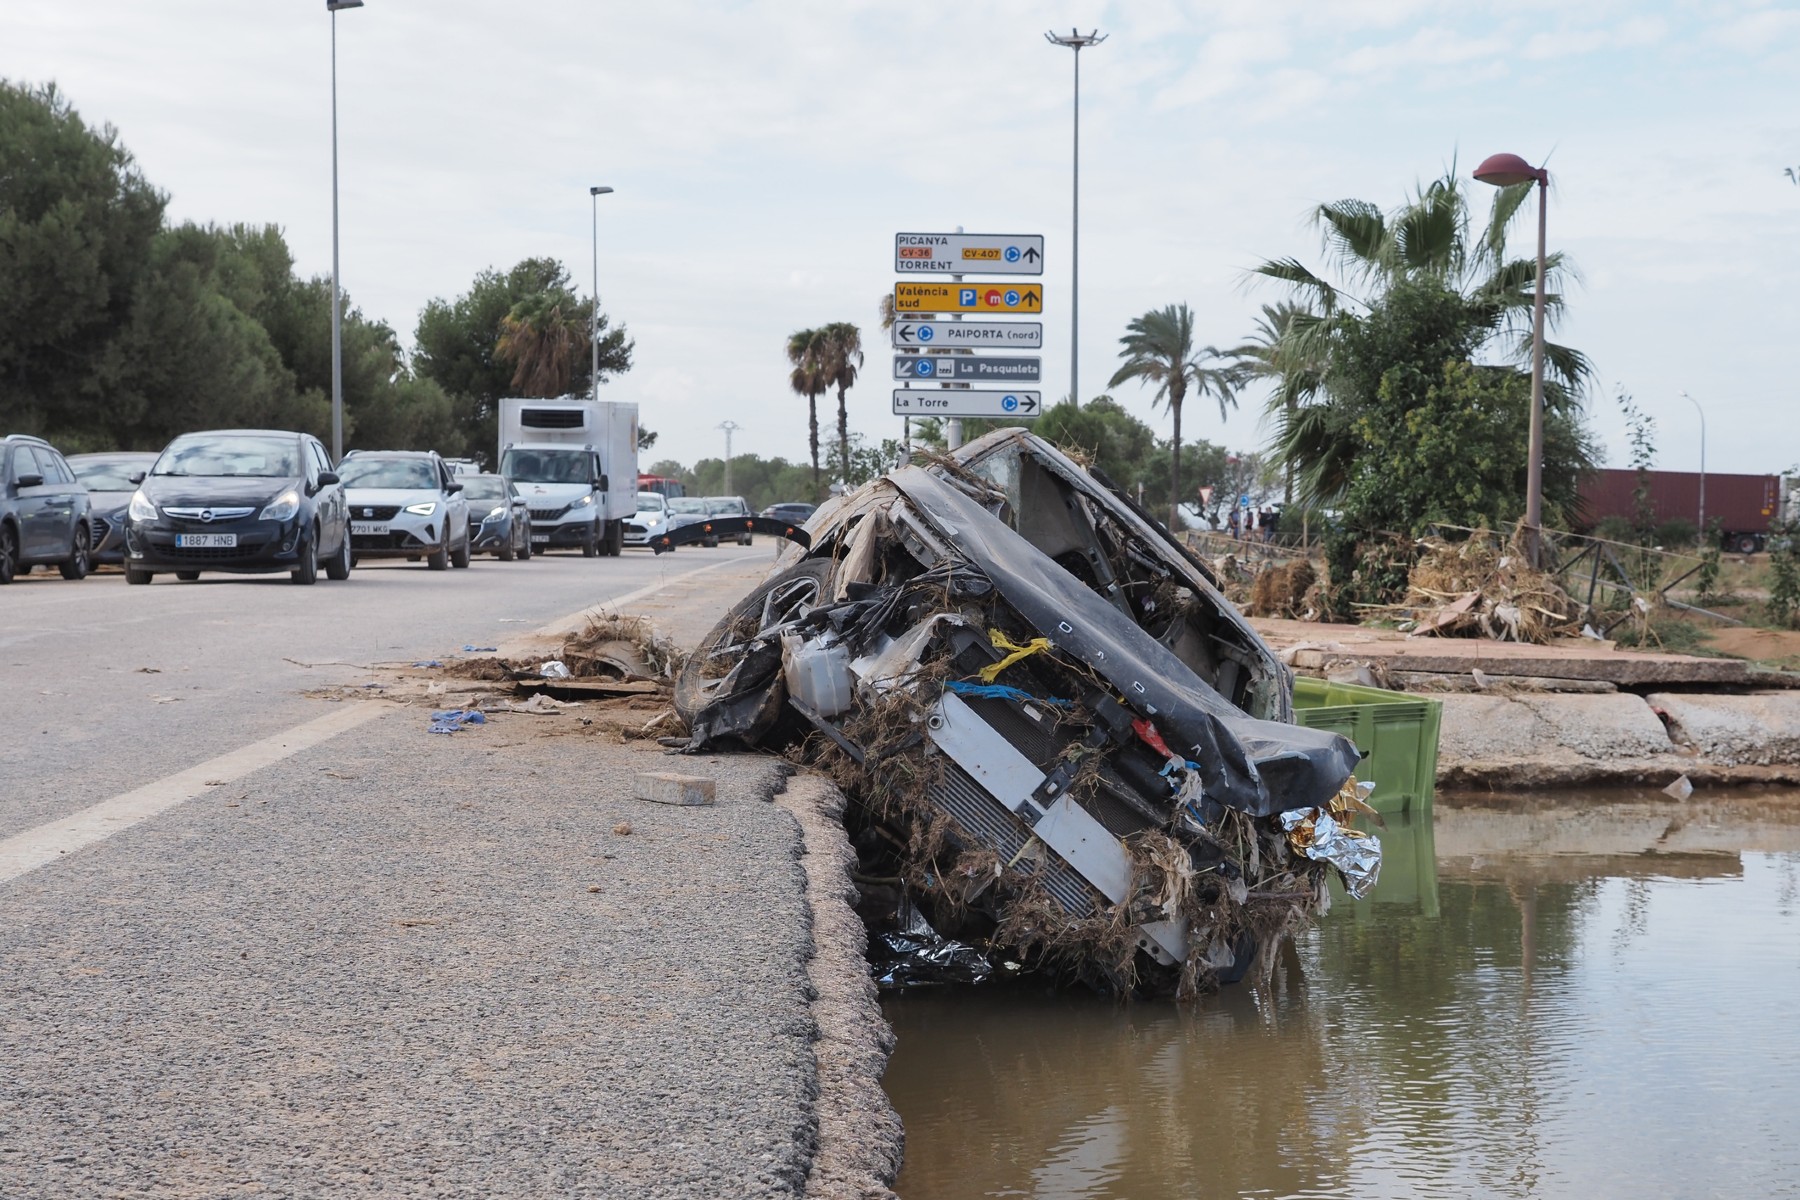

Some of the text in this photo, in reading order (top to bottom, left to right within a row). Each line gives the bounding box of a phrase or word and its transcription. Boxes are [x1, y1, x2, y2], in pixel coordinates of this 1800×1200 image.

[899, 237, 948, 245] PICANYA
[901, 249, 930, 257] CV-36
[964, 250, 999, 258] CV-407
[899, 261, 952, 269] TORRENT
[899, 287, 948, 296] València
[899, 299, 920, 307] sud
[948, 329, 1039, 340] PAIPORTA (nord)
[961, 363, 1038, 375] La Pasqualeta
[896, 397, 949, 407] La Torre
[184, 535, 233, 546] 1887 HNB
